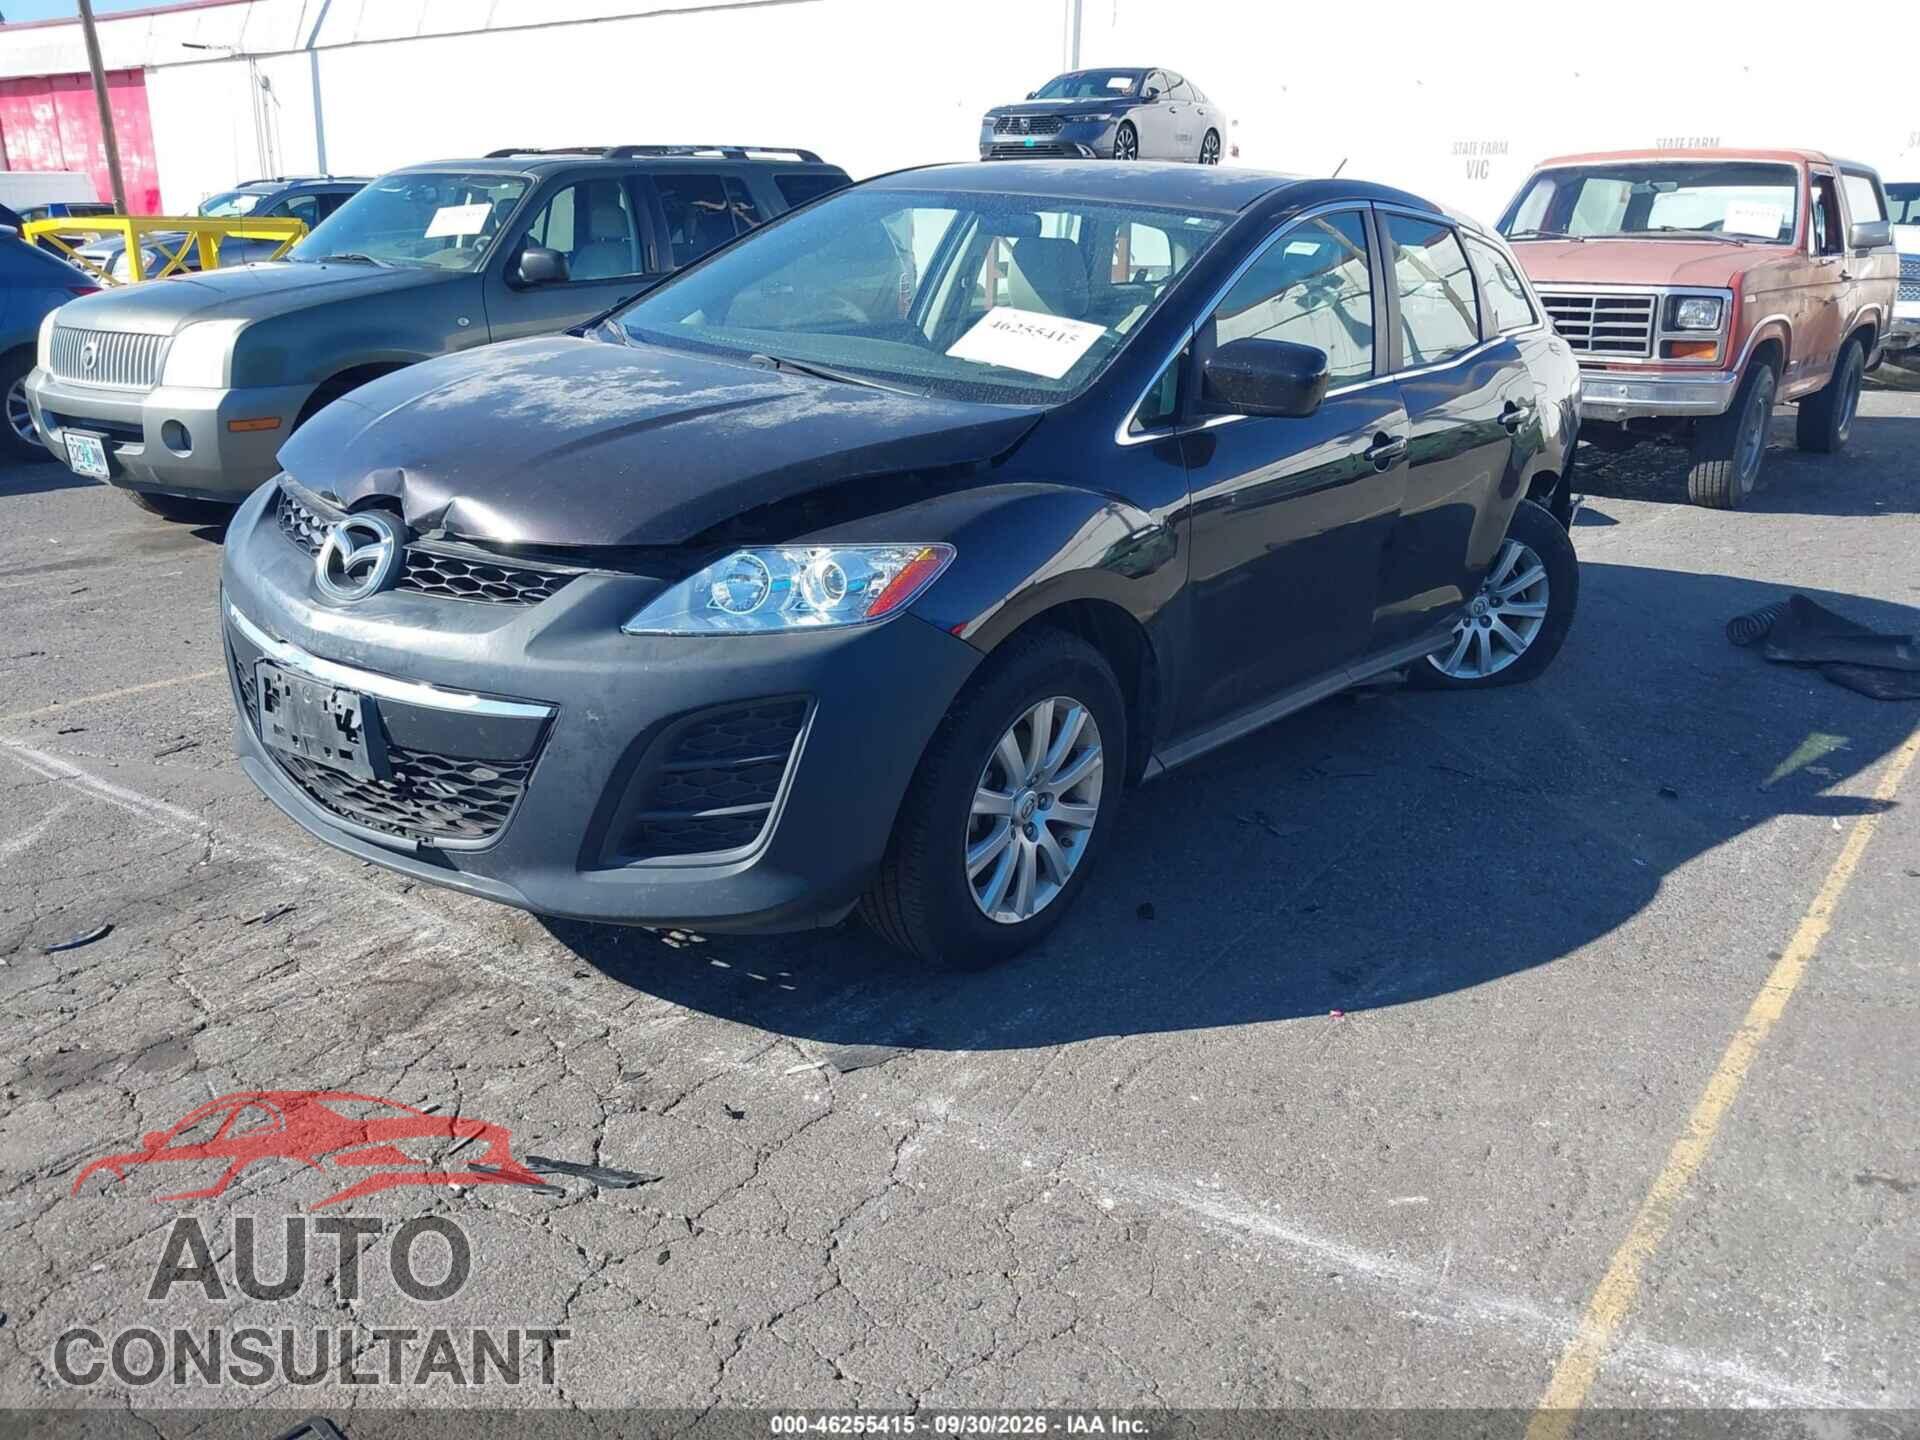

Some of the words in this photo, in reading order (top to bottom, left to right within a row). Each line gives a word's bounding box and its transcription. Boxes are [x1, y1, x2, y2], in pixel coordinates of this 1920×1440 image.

[1452, 141, 1478, 156] STATE
[1480, 140, 1509, 155] FARM
[1466, 159, 1489, 180] VIC
